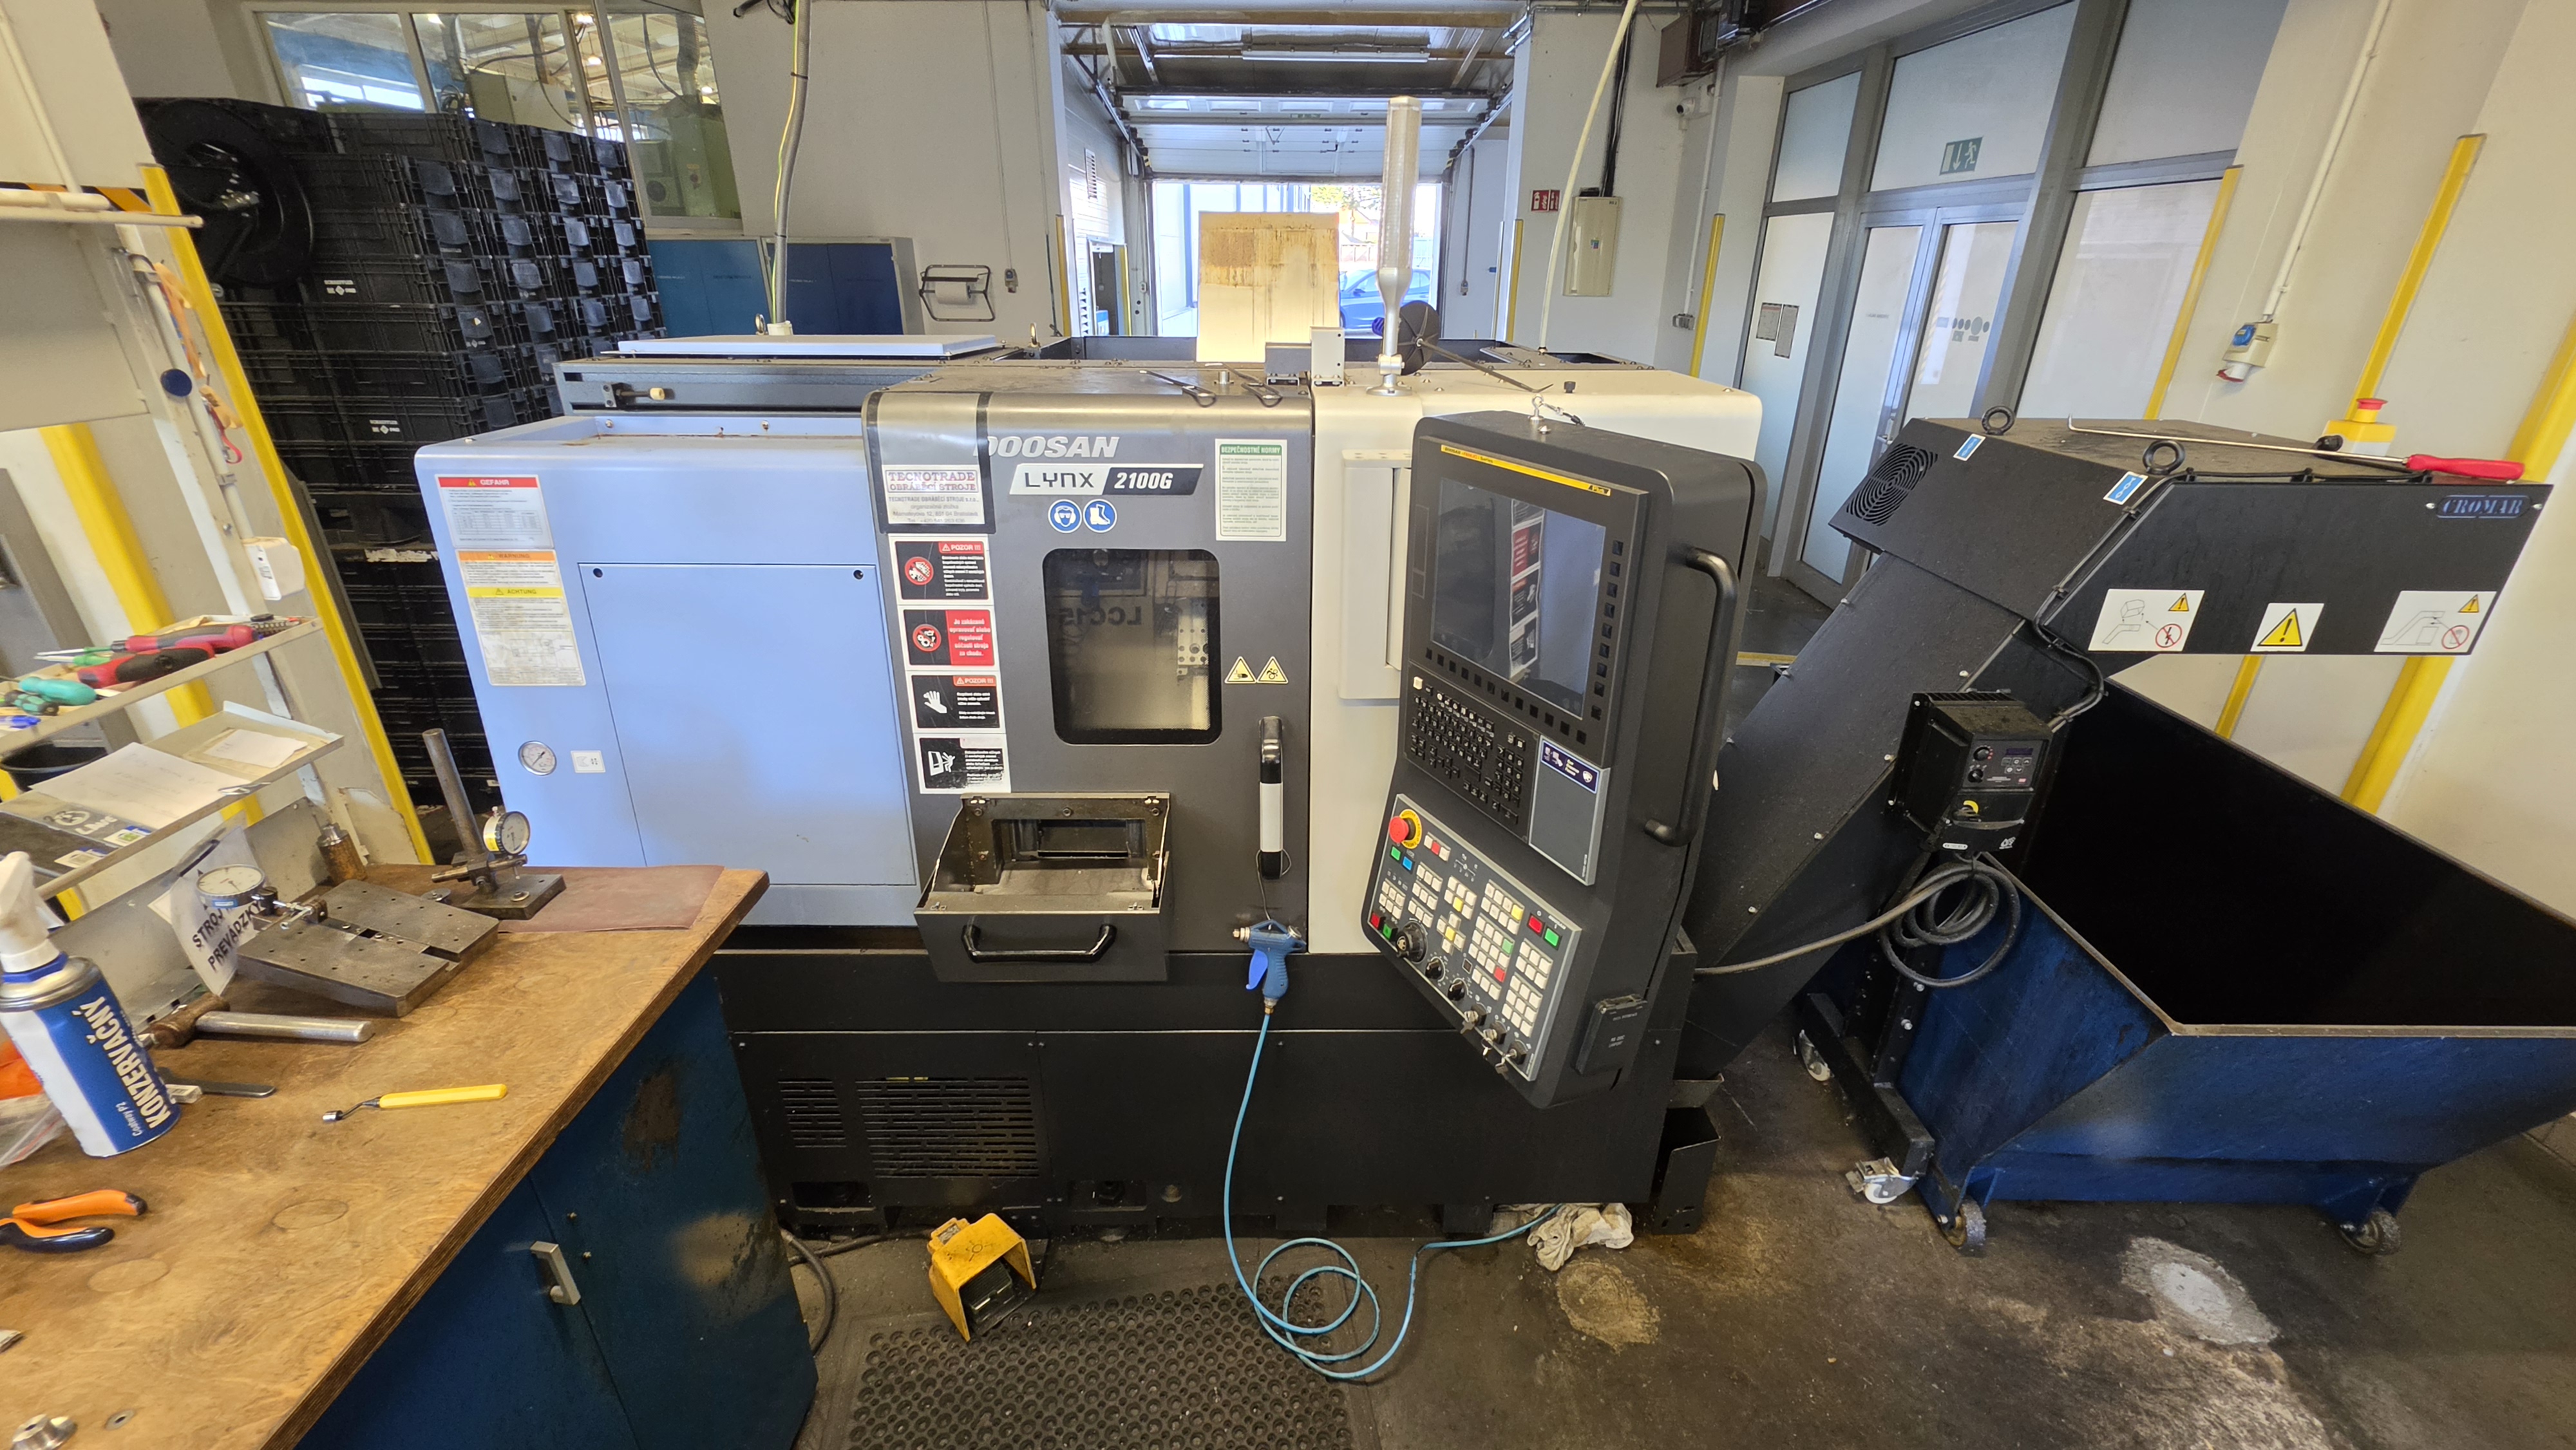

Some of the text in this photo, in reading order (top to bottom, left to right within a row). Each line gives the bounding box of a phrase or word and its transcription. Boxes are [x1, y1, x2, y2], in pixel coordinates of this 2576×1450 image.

[888, 472, 975, 481] TECNOTRADE
[1025, 472, 1173, 489] LYNX 2100G
[890, 482, 936, 491] OBRÁBĚCÍ
[2443, 500, 2523, 514] CROMAR
[193, 909, 223, 948] STROJ
[207, 901, 262, 971] PREVÁDZKY
[71, 997, 171, 1129] KONZERVAČNÝ
[115, 1102, 127, 1112] P2
